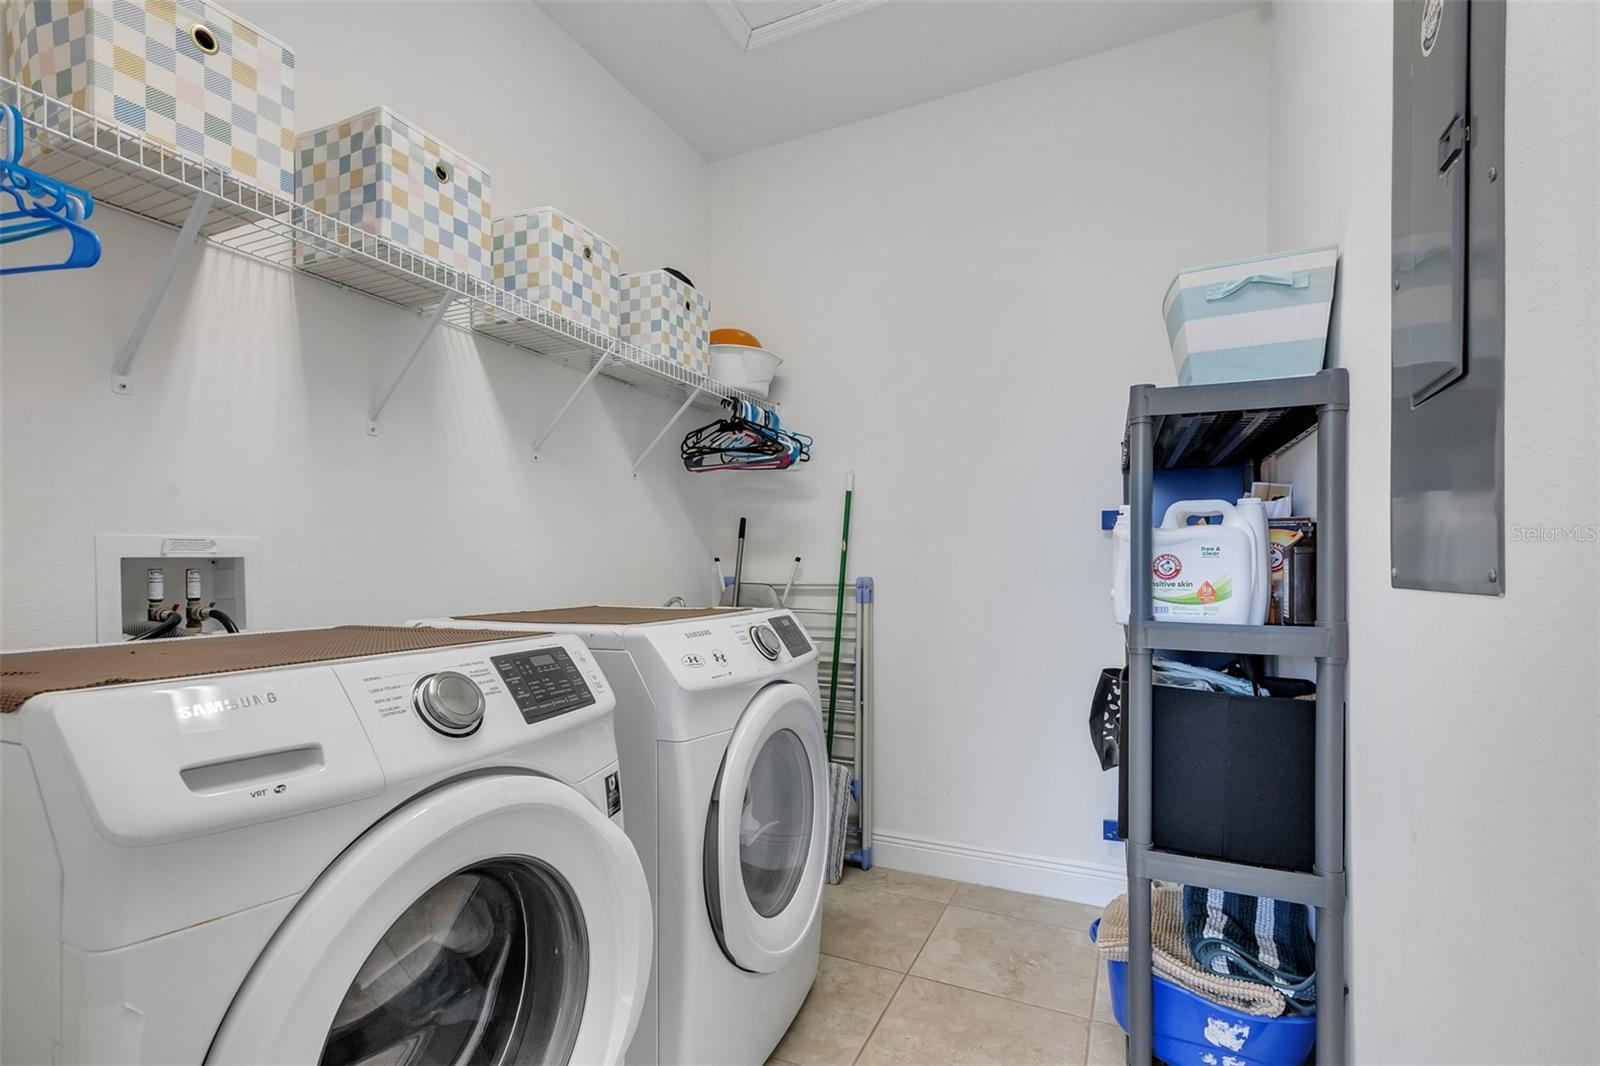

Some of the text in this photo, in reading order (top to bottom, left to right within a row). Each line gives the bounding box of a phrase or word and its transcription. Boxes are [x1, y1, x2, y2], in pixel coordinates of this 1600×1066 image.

[1177, 580, 1194, 588] skin
[684, 629, 712, 639] SAMSUNG
[176, 692, 278, 720] SAMSUNG
